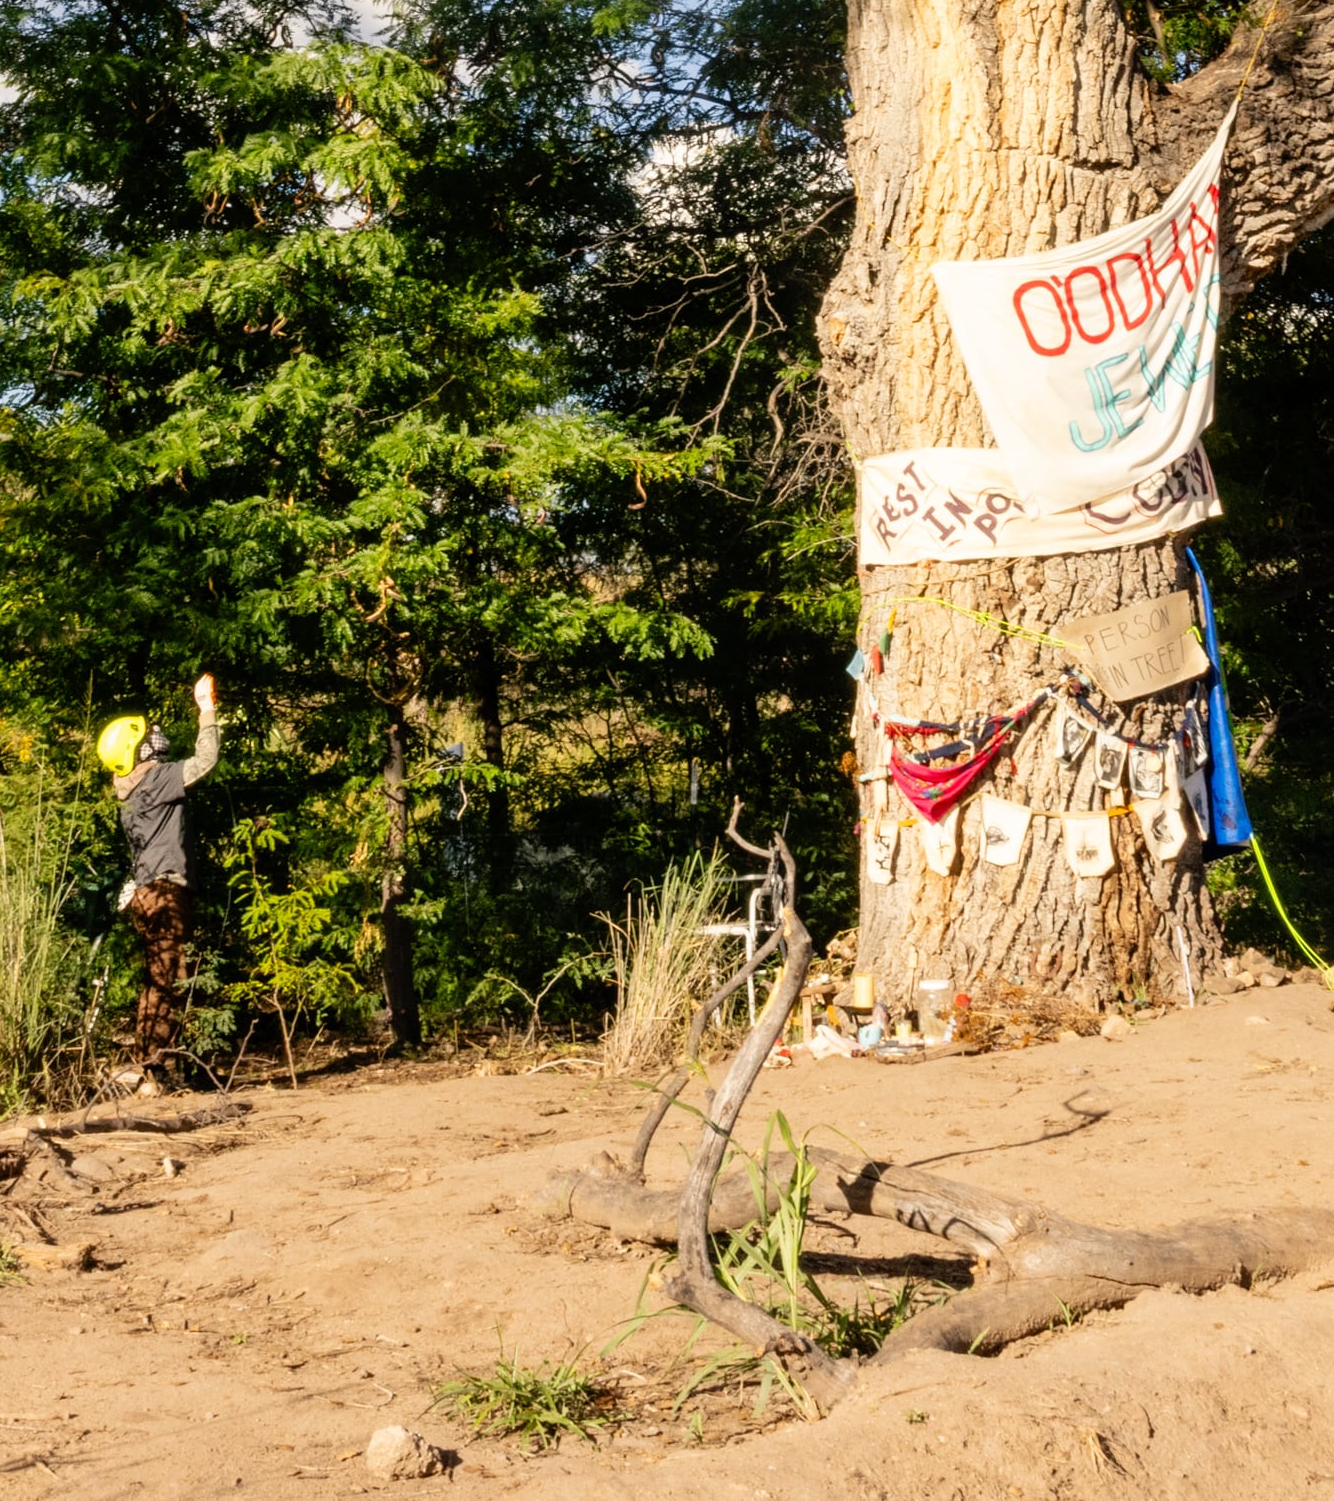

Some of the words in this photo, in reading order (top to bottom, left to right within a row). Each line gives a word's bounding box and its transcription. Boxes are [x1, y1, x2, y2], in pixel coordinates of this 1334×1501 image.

[1013, 183, 1220, 357] O'ODHA
[876, 460, 926, 555] REST
[922, 487, 974, 542] IN
[973, 493, 1026, 549] PO
[1084, 605, 1170, 655] PERSON
[1108, 662, 1130, 689] IN
